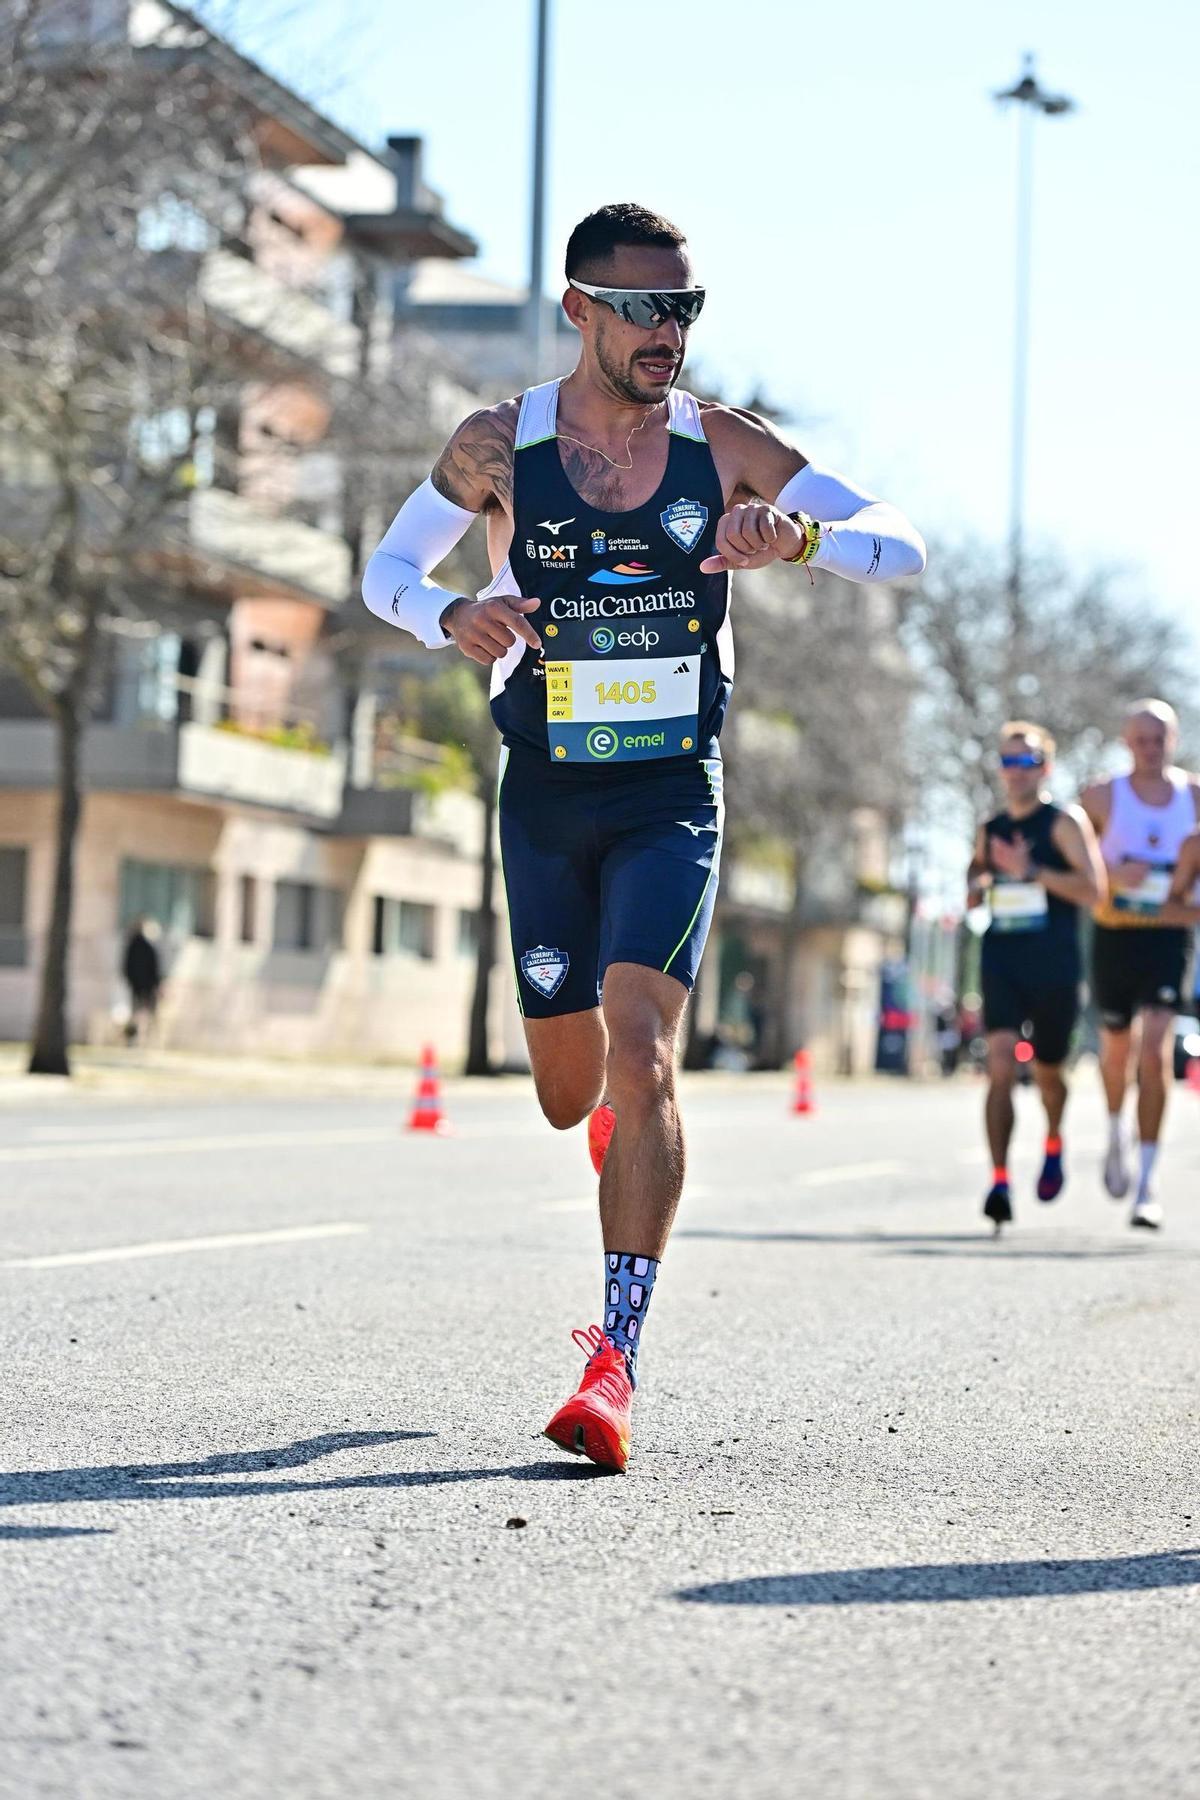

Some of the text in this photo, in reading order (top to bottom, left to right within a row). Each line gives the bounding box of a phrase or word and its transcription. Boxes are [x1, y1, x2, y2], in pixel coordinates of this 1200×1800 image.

[672, 504, 696, 513] TENERIFE
[668, 511, 701, 520] CAJACANARIAS
[538, 545, 578, 559] DXT
[541, 560, 576, 569] TENERIFE
[550, 587, 695, 620] CajaCanarias
[617, 625, 659, 651] edp
[563, 680, 568, 689] 1
[594, 680, 657, 705] 1405
[623, 732, 664, 748] emel
[530, 951, 554, 960] TENERIFE
[527, 957, 560, 966] CAJACANARIAS
